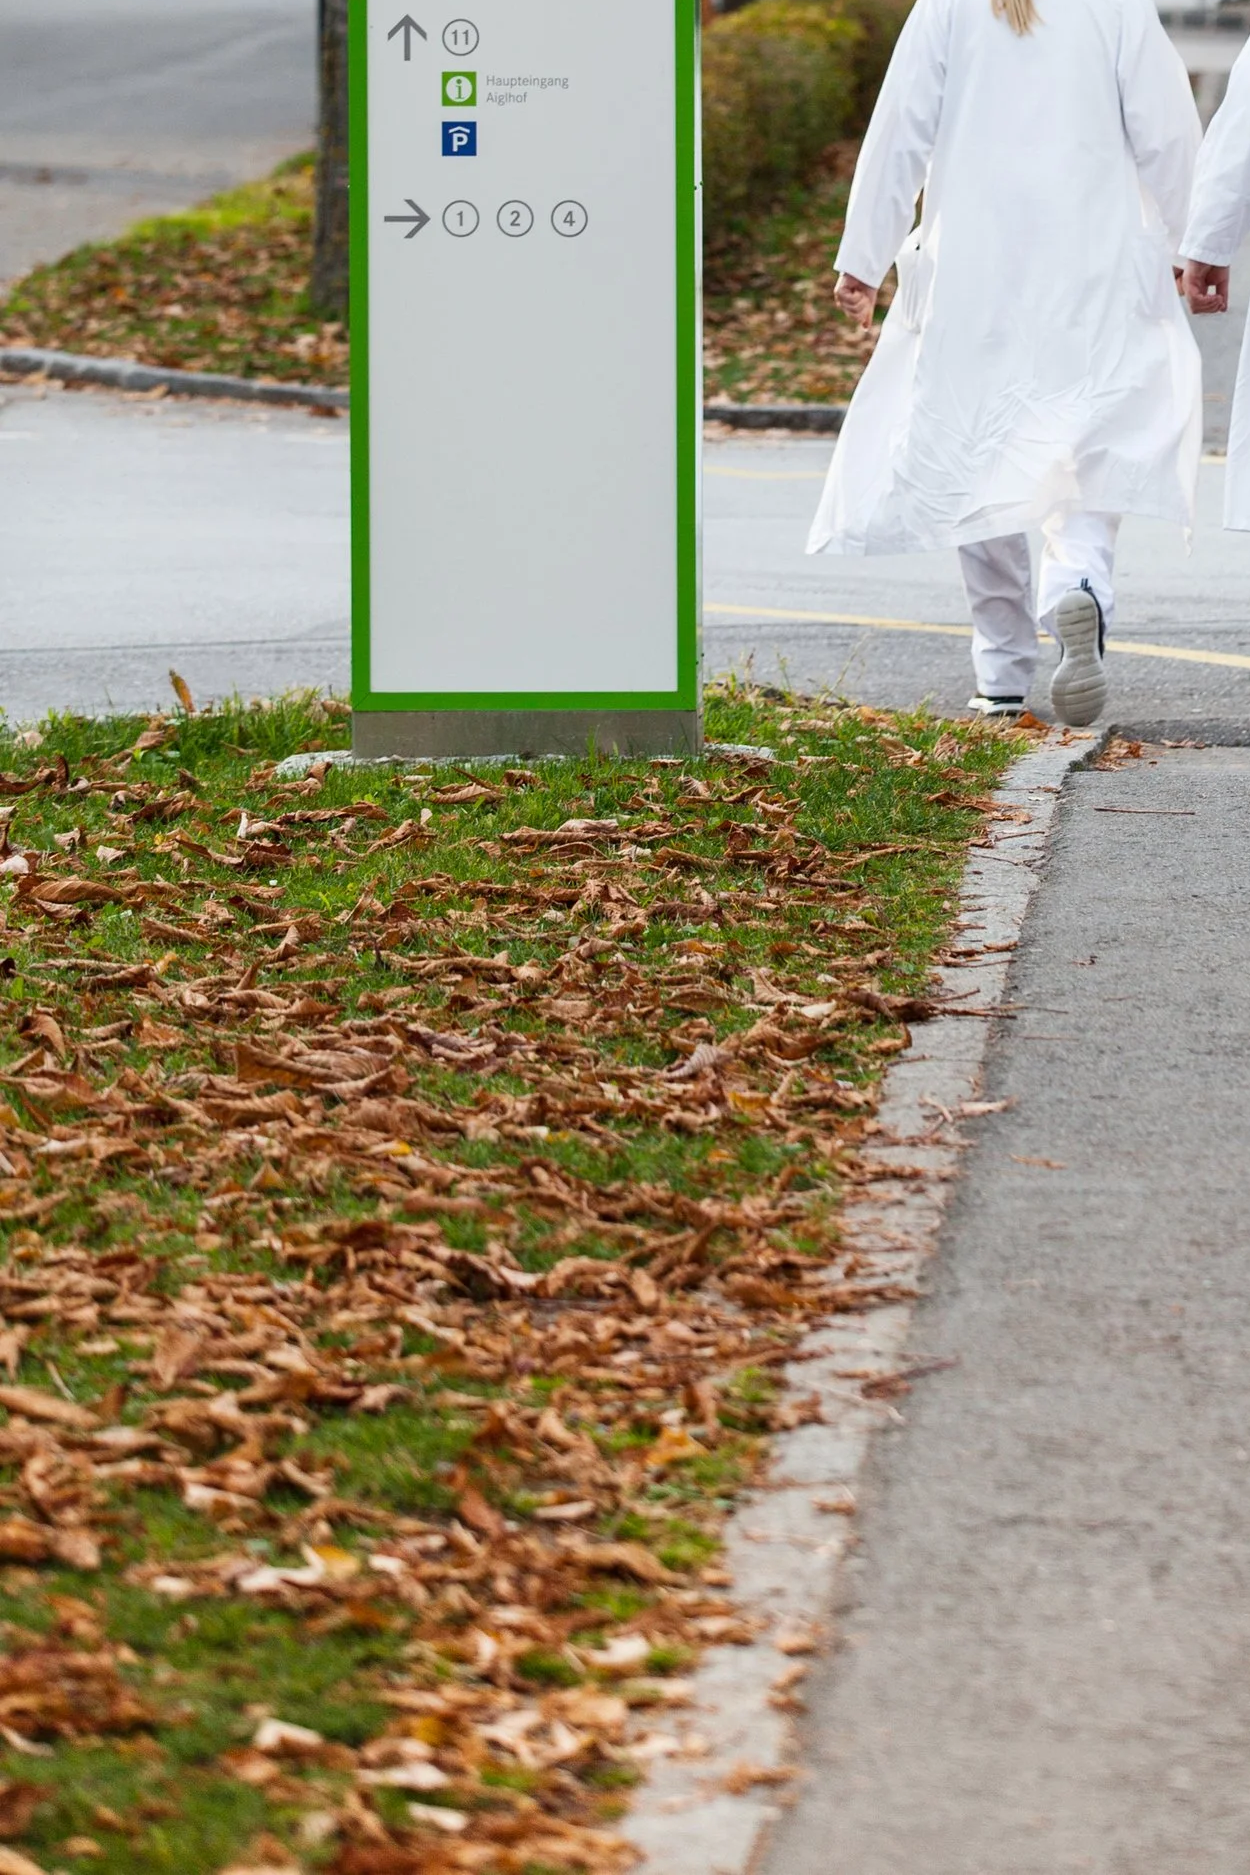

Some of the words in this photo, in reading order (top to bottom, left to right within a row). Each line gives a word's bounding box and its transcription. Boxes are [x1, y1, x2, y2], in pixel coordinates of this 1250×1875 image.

[451, 29, 469, 46] 11
[486, 76, 569, 89] Haupteingang
[486, 92, 527, 106] Aiglhof
[452, 132, 468, 152] P
[456, 210, 464, 227] 1
[509, 210, 521, 227] 2
[562, 210, 576, 227] 4
